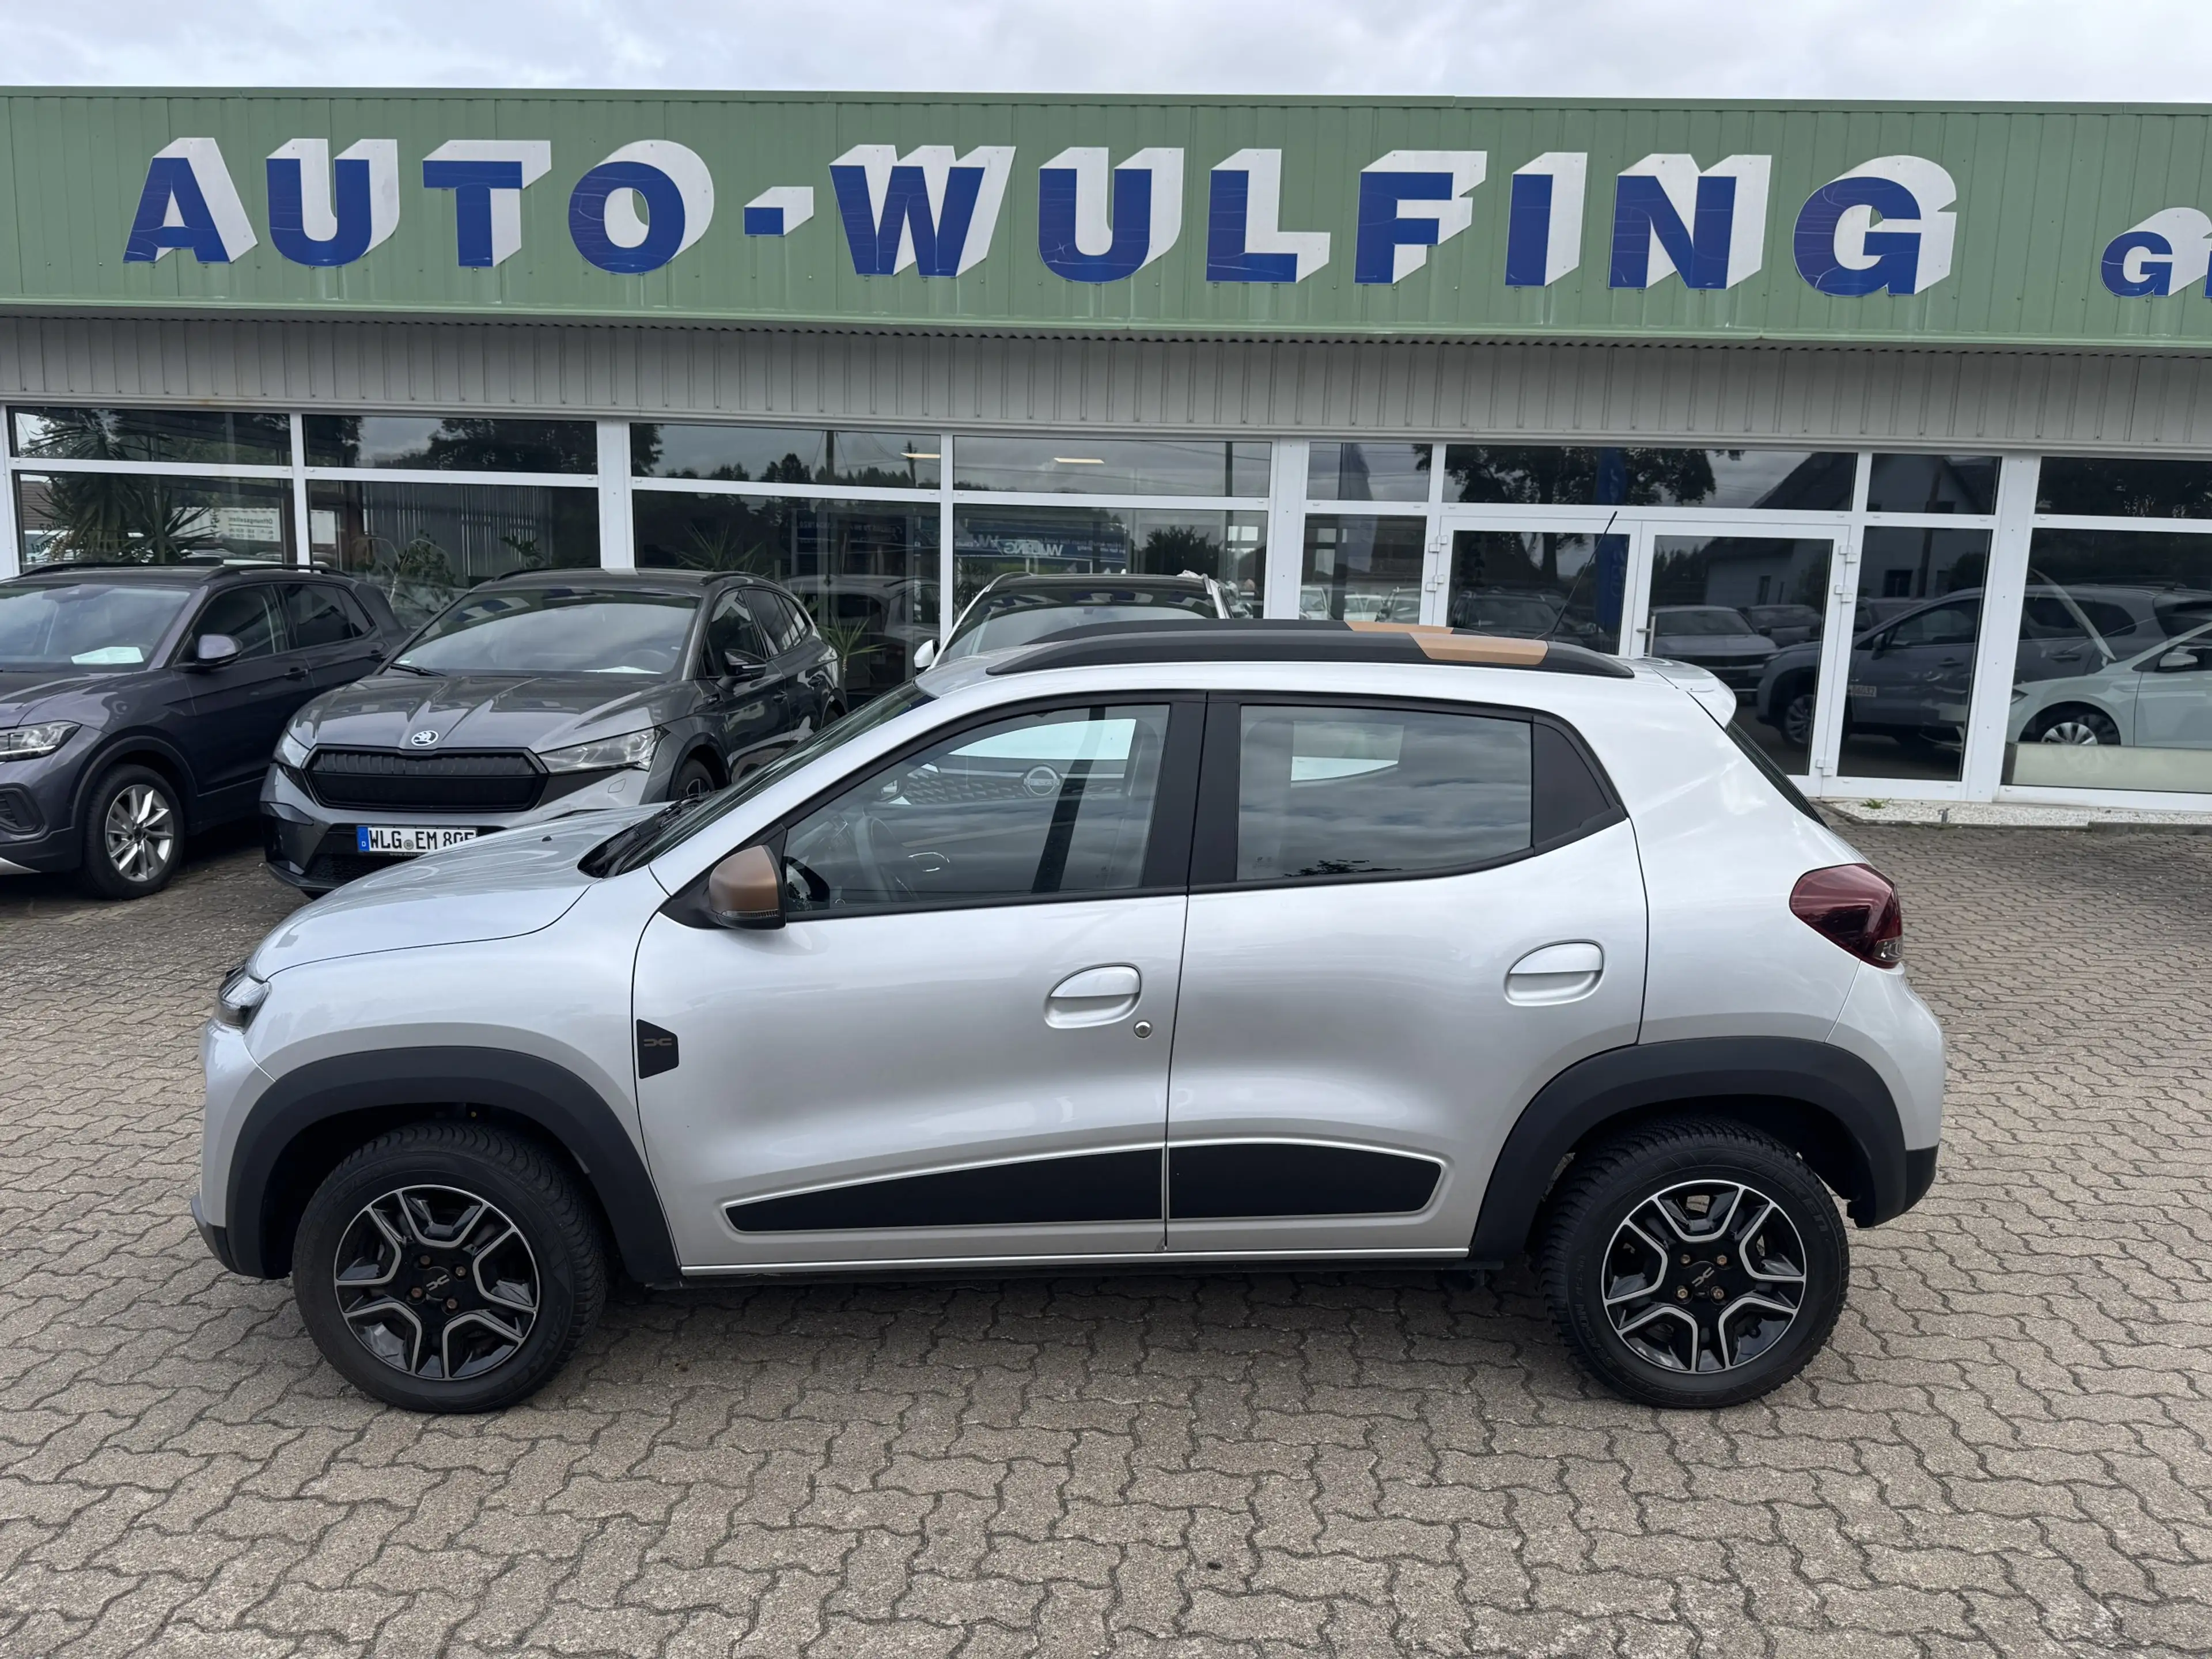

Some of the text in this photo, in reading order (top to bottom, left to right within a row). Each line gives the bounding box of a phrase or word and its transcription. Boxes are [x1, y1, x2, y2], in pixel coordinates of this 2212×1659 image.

[2100, 207, 2212, 298] G
[1024, 778, 1060, 786] NISSAN
[369, 830, 402, 849] WLG
[416, 831, 438, 850] EM
